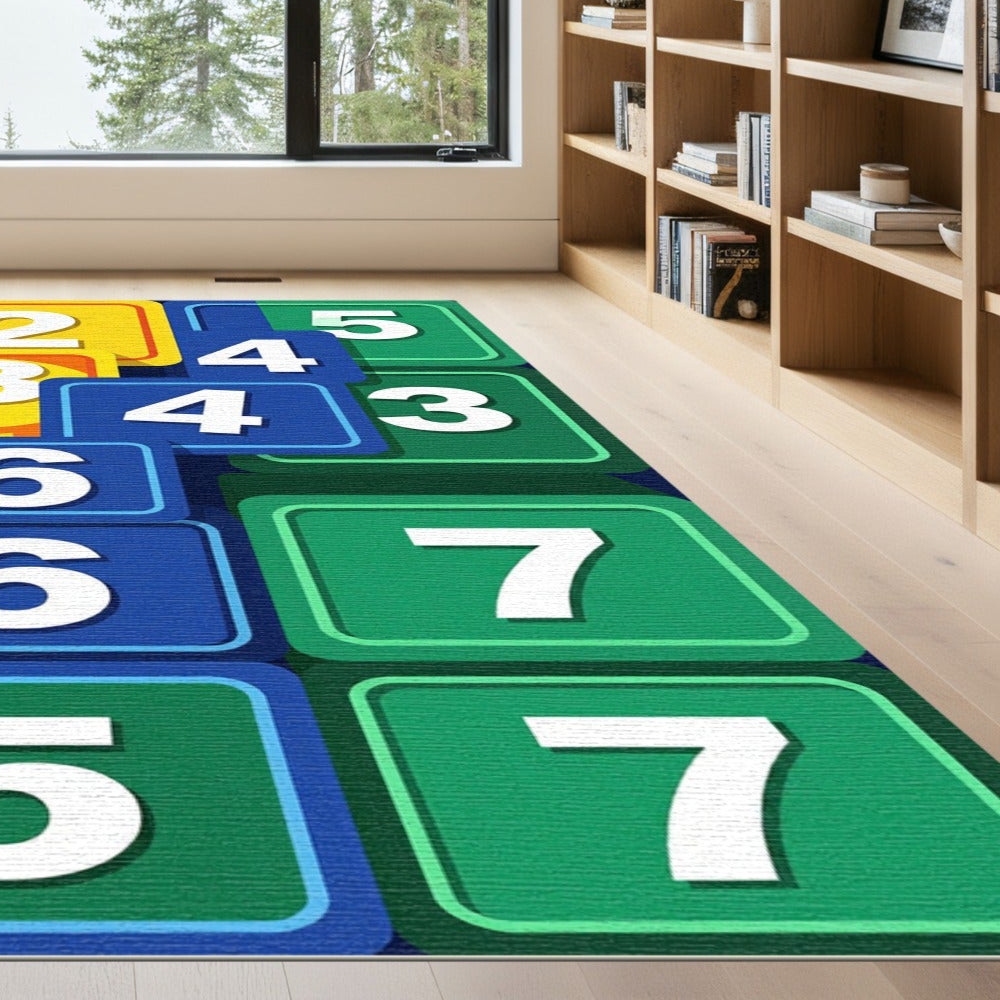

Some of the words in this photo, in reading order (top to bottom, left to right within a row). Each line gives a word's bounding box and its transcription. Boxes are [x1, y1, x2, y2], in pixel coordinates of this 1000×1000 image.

[312, 310, 419, 340] 5
[197, 339, 318, 373] 4
[123, 389, 263, 435] 4
[367, 386, 513, 433] 3
[406, 527, 605, 619] 7
[524, 716, 790, 882] 7
